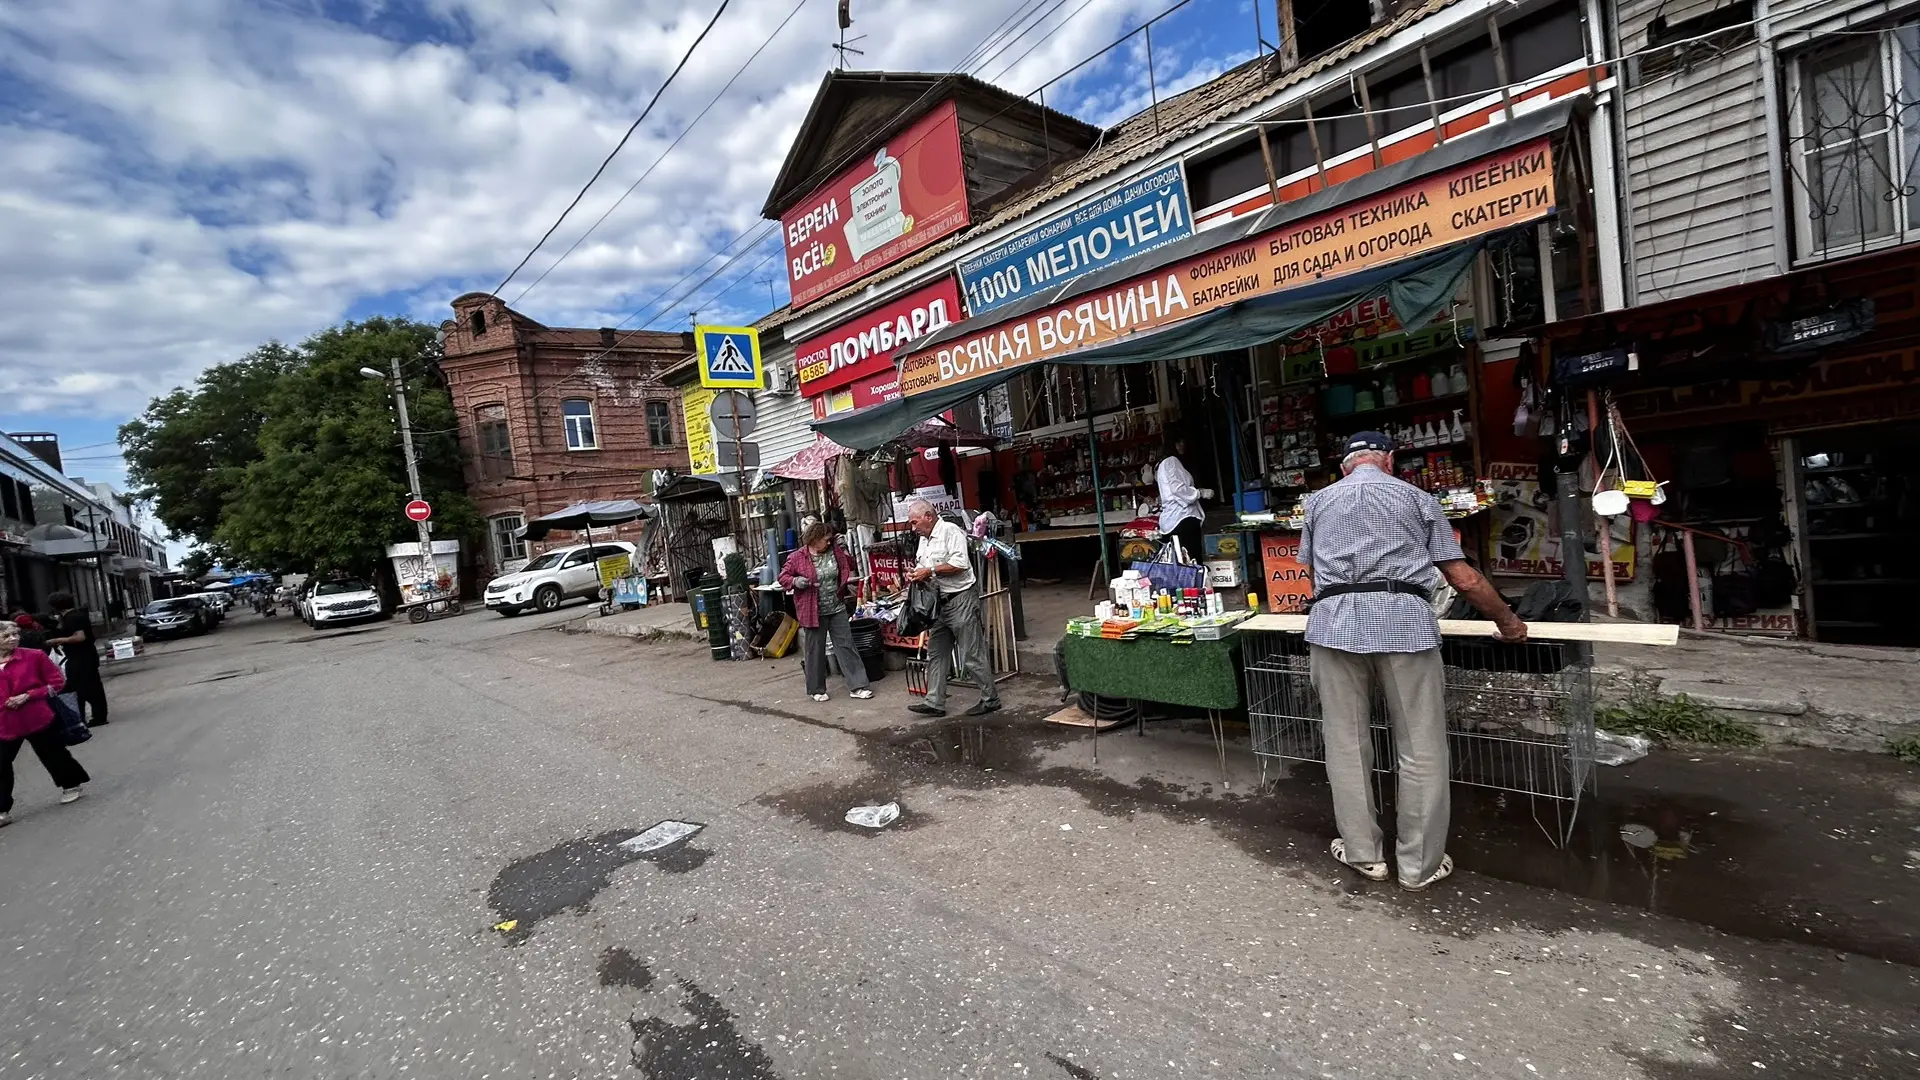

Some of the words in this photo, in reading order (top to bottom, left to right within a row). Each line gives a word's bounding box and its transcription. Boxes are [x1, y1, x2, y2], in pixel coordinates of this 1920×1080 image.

[862, 178, 884, 196] ЗОЛОТО
[1448, 151, 1545, 199] КЛЕЁНКИ
[856, 186, 893, 213] ЭЛЕКТРОНИКУ
[864, 203, 888, 221] ТЕХНИКУ
[1451, 185, 1549, 231] СКАТЕРТИ
[788, 197, 839, 248] БЕРЕМ
[982, 249, 1008, 265] СКАТЕРТИ
[1008, 233, 1040, 254] БАТАРЕЙКИ
[1039, 218, 1073, 238] ФОНАРИКИ
[1088, 204, 1103, 219] ДЛЯ
[1103, 195, 1123, 212] ДОМА
[1269, 218, 1347, 257] БЫТОВАЯ
[1347, 191, 1429, 230] ТЕХНИКА
[792, 240, 826, 281] ВСЁ!
[969, 265, 1021, 307] 1000
[1026, 186, 1184, 285] МЕЛОЧЕЙ
[1273, 263, 1300, 286] ДЛЯ
[1303, 250, 1342, 275] САДА
[1344, 245, 1355, 262] И
[1358, 221, 1433, 258] ОГОРОДА
[1190, 248, 1257, 282] ФОНАРИКИ
[1193, 274, 1260, 307] БАТАРЕЙКИ
[828, 300, 953, 372] ЛОМБАРД
[938, 322, 1032, 381] ВСЯКАЯ
[1039, 274, 1189, 348] ВСЯЧИНА
[1793, 323, 1836, 341] SPORT
[798, 350, 825, 368] ПРОСТО
[809, 362, 826, 379] 585
[1582, 359, 1614, 373] SPORT
[900, 372, 940, 392] ХОЗТОВАРЫ
[932, 500, 961, 513] МБАРД
[1267, 545, 1300, 558] ПОБ
